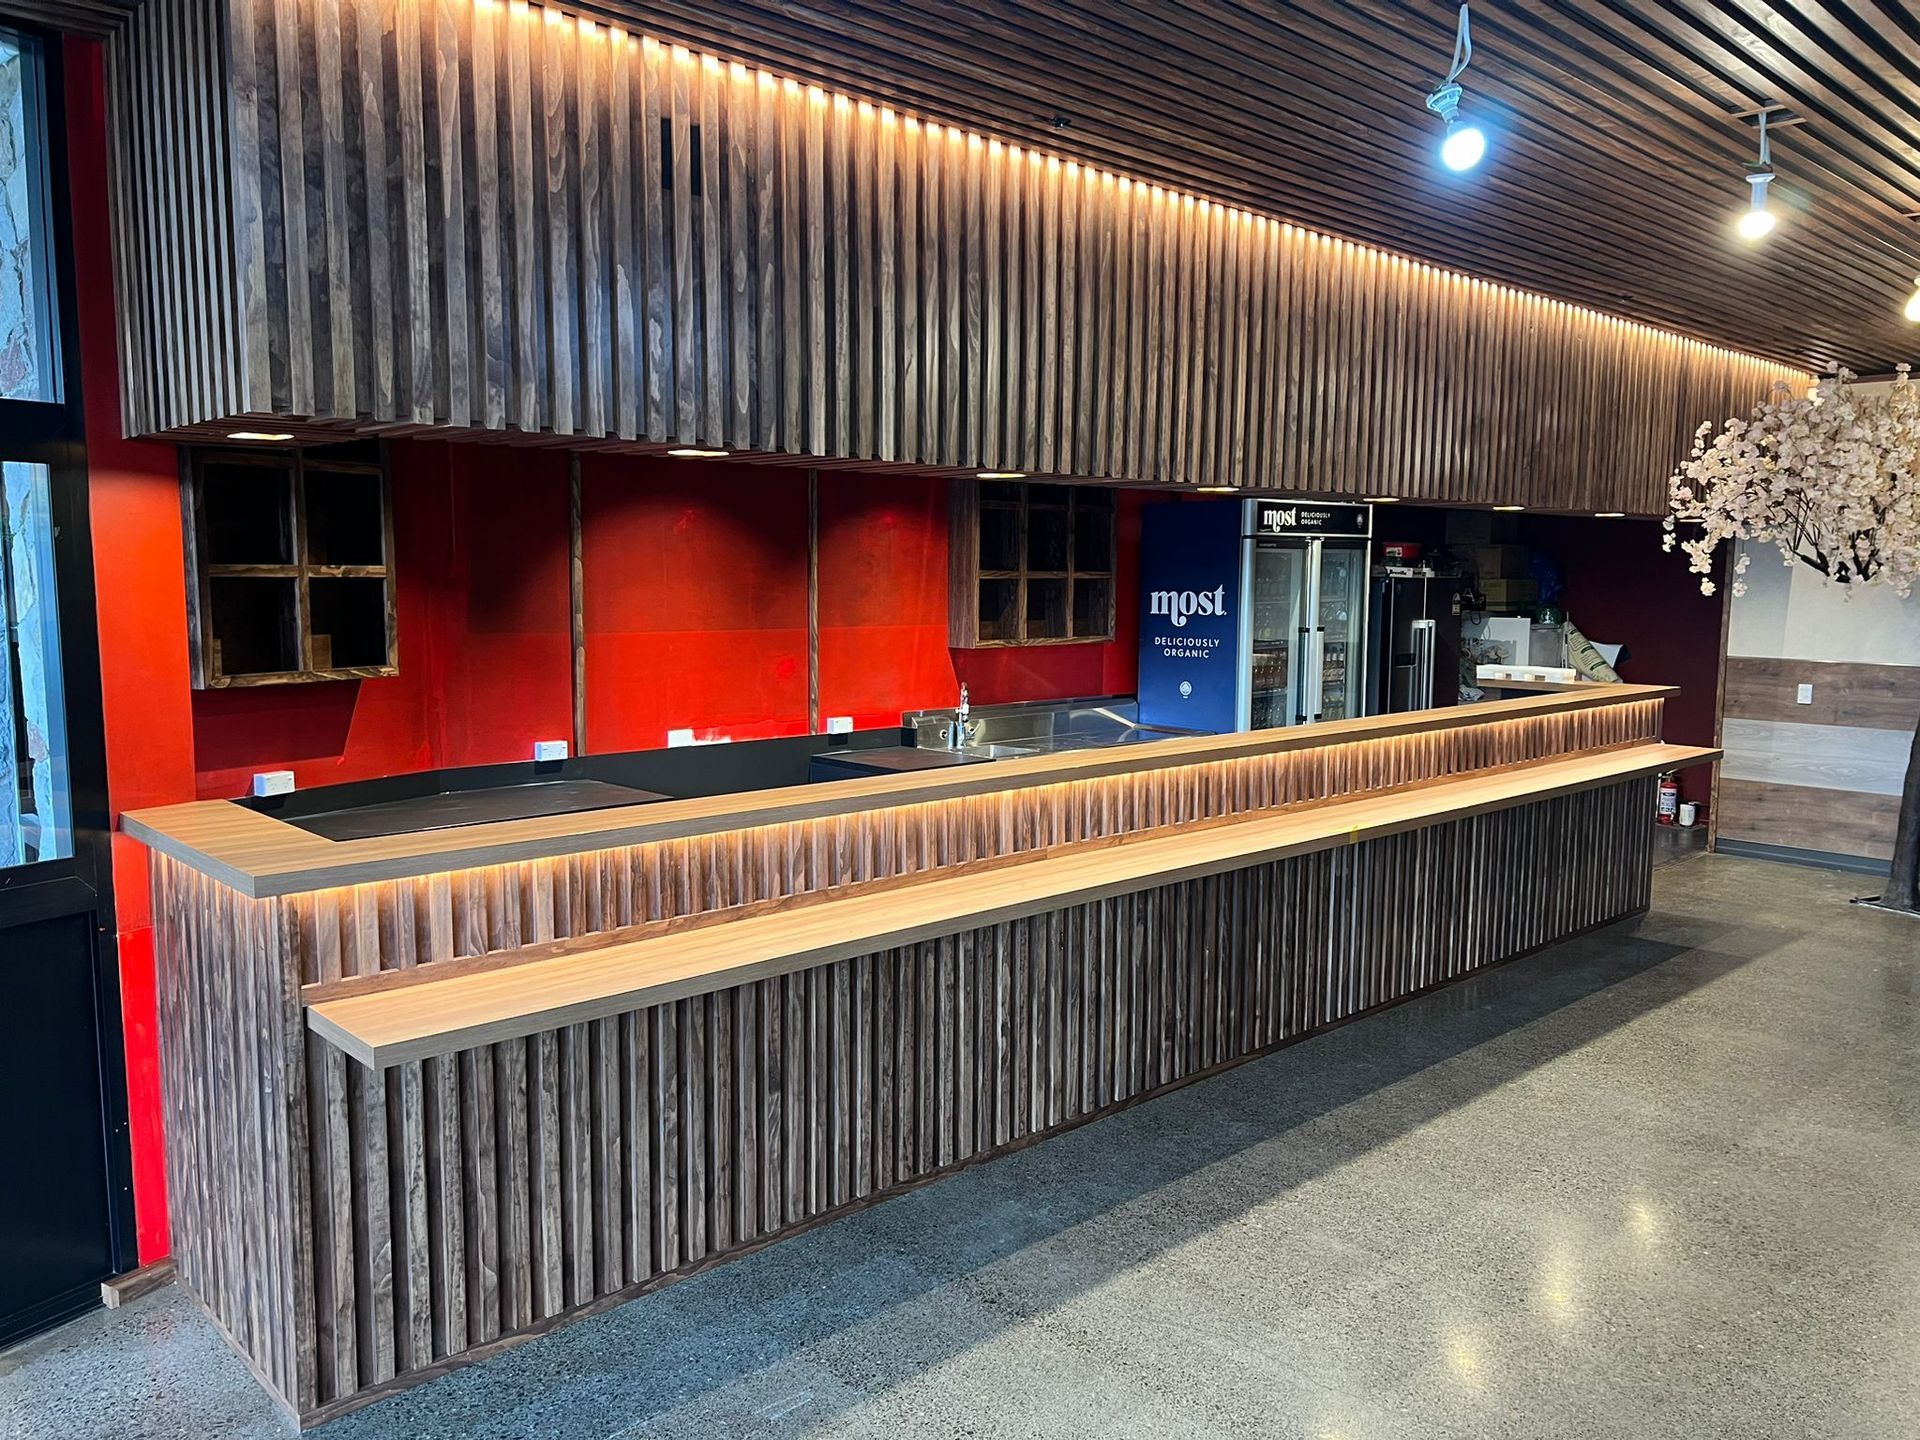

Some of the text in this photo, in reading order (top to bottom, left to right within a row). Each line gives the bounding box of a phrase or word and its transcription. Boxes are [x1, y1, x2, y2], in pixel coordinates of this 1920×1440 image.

[1263, 507, 1296, 533] most
[1301, 511, 1330, 519] DELICIOUSLY
[1154, 636, 1220, 648] DELICIOUSLY
[1163, 648, 1210, 659] ORGANIC
